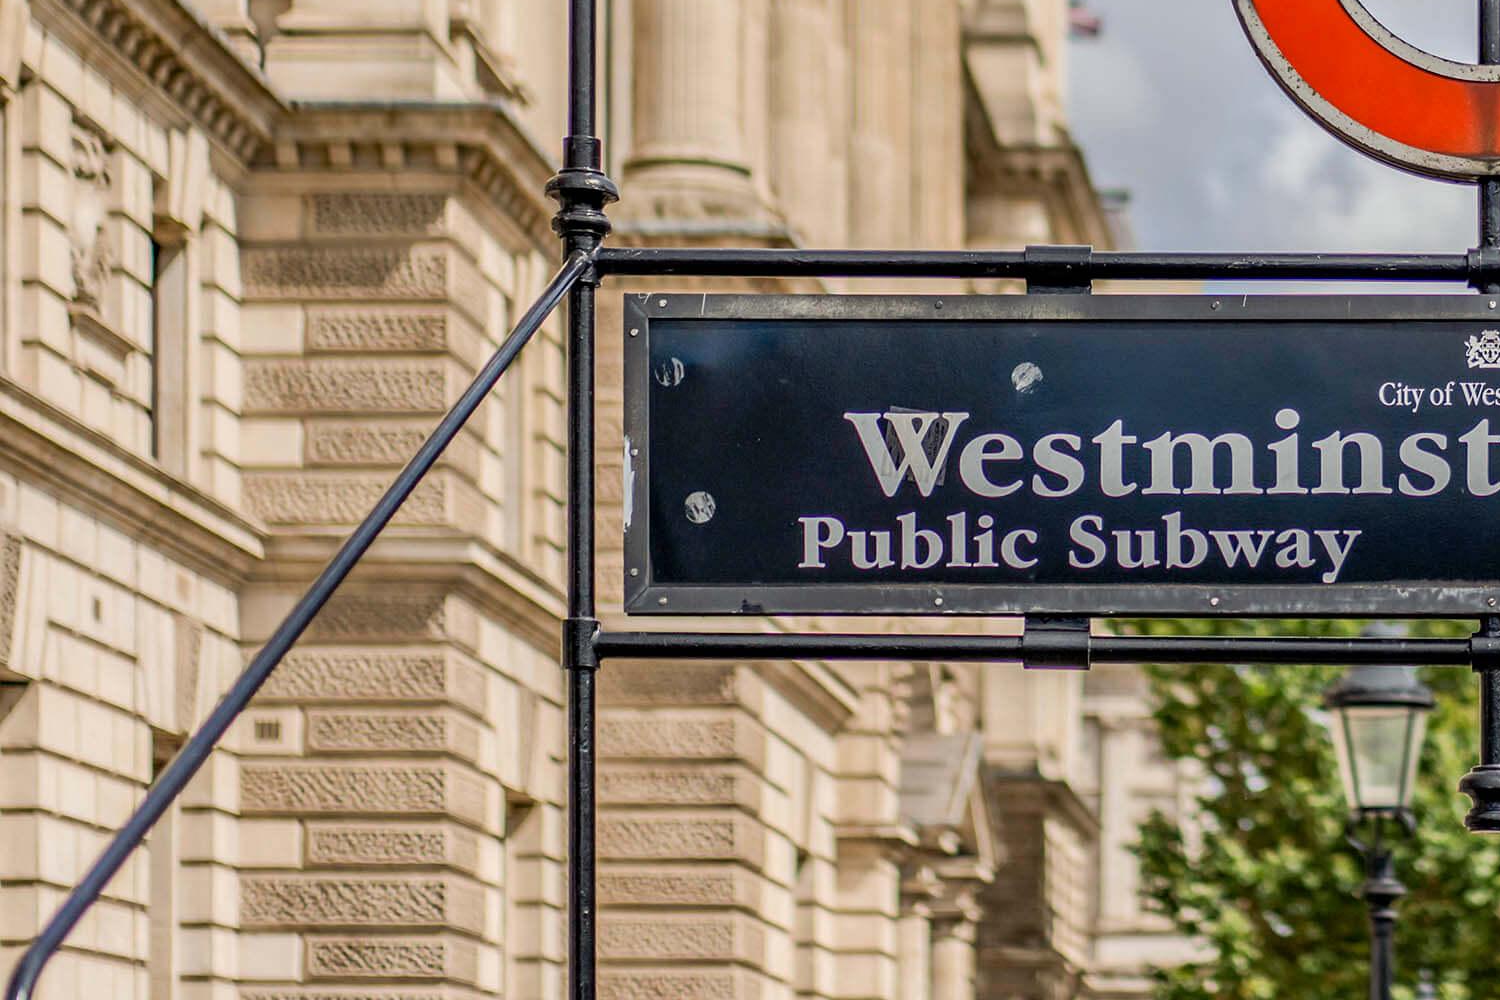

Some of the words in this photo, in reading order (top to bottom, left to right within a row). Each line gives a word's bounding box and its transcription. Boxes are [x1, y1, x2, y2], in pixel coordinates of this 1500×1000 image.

[1378, 381, 1425, 413] City
[1429, 380, 1456, 406] of
[797, 511, 1039, 570] Public
[1068, 511, 1363, 585] Subway
